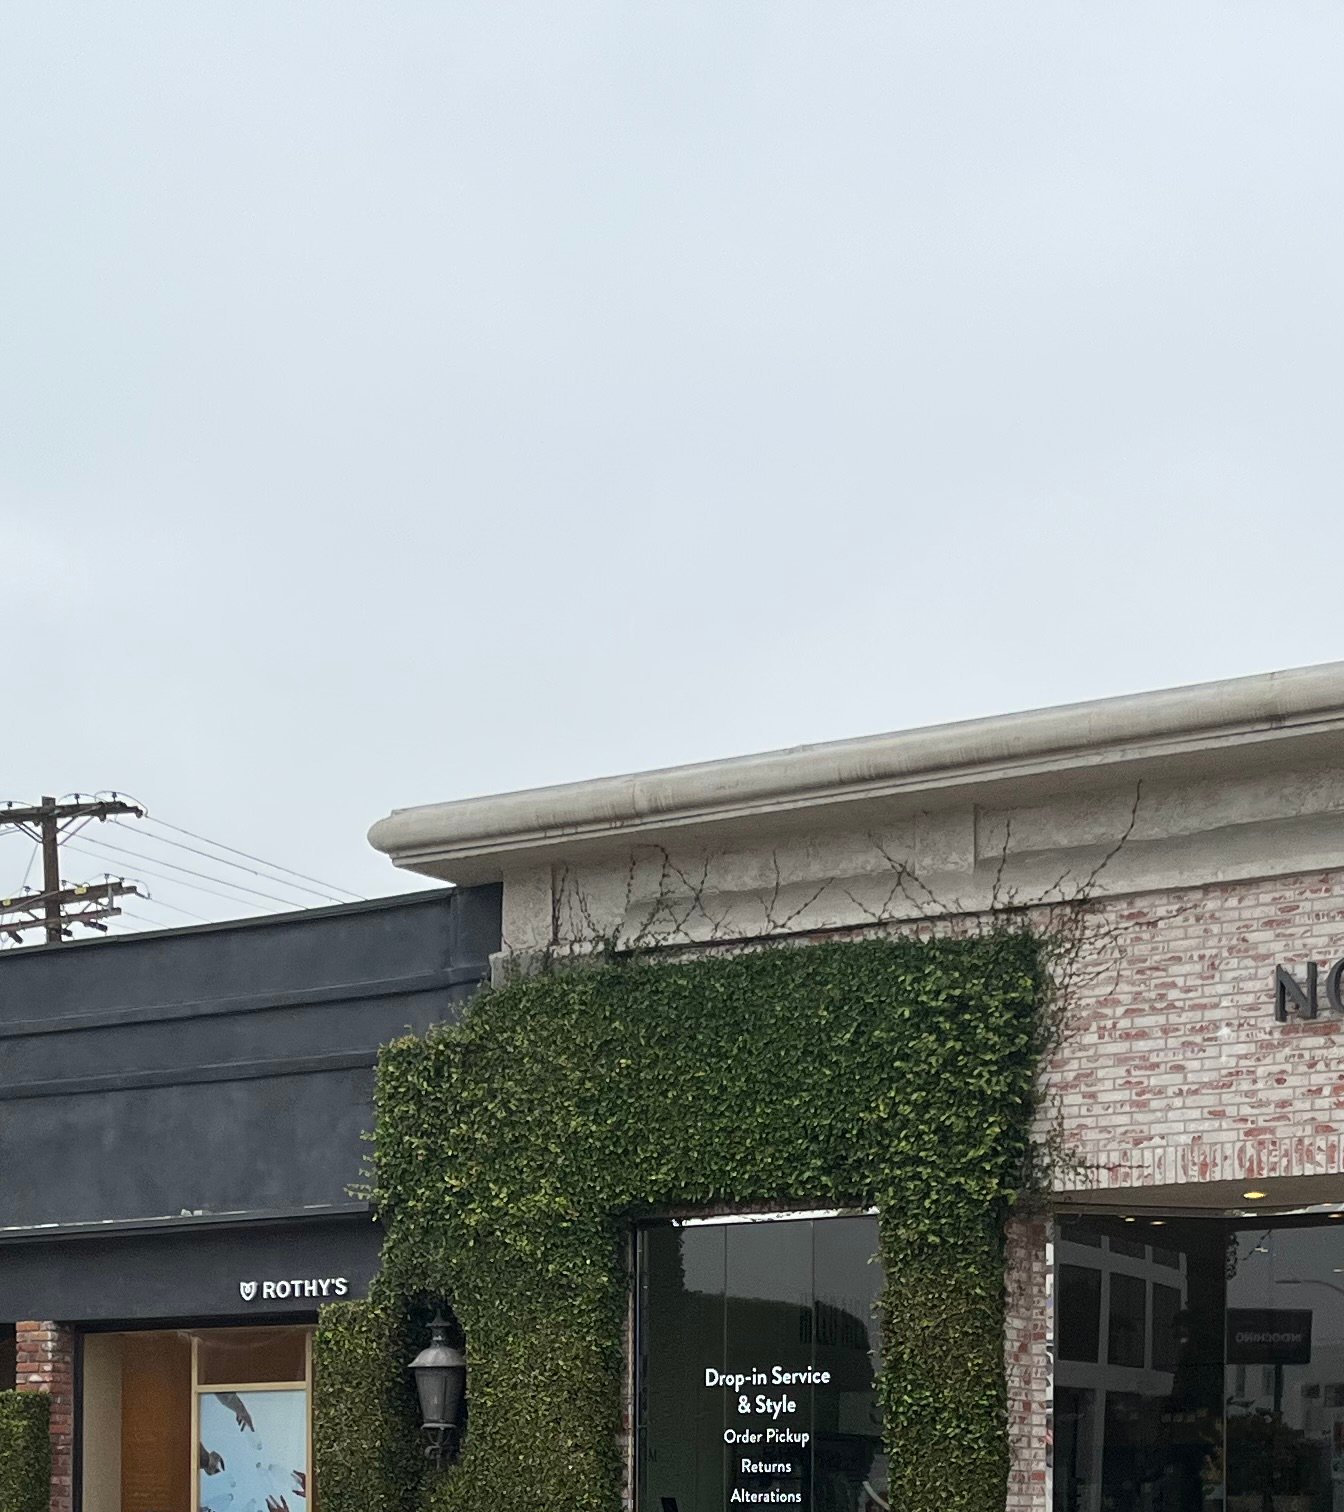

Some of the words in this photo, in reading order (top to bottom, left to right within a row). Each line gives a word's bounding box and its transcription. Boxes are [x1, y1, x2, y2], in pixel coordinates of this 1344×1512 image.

[263, 1278, 348, 1299] ROTHY'S
[705, 1367, 767, 1393] Drop-in
[771, 1366, 831, 1385] Service
[738, 1395, 751, 1414] &
[755, 1394, 797, 1420] Style
[723, 1429, 763, 1443] Order
[766, 1428, 810, 1448] Pickup
[741, 1458, 792, 1473] Returns
[730, 1488, 802, 1503] Alterations
